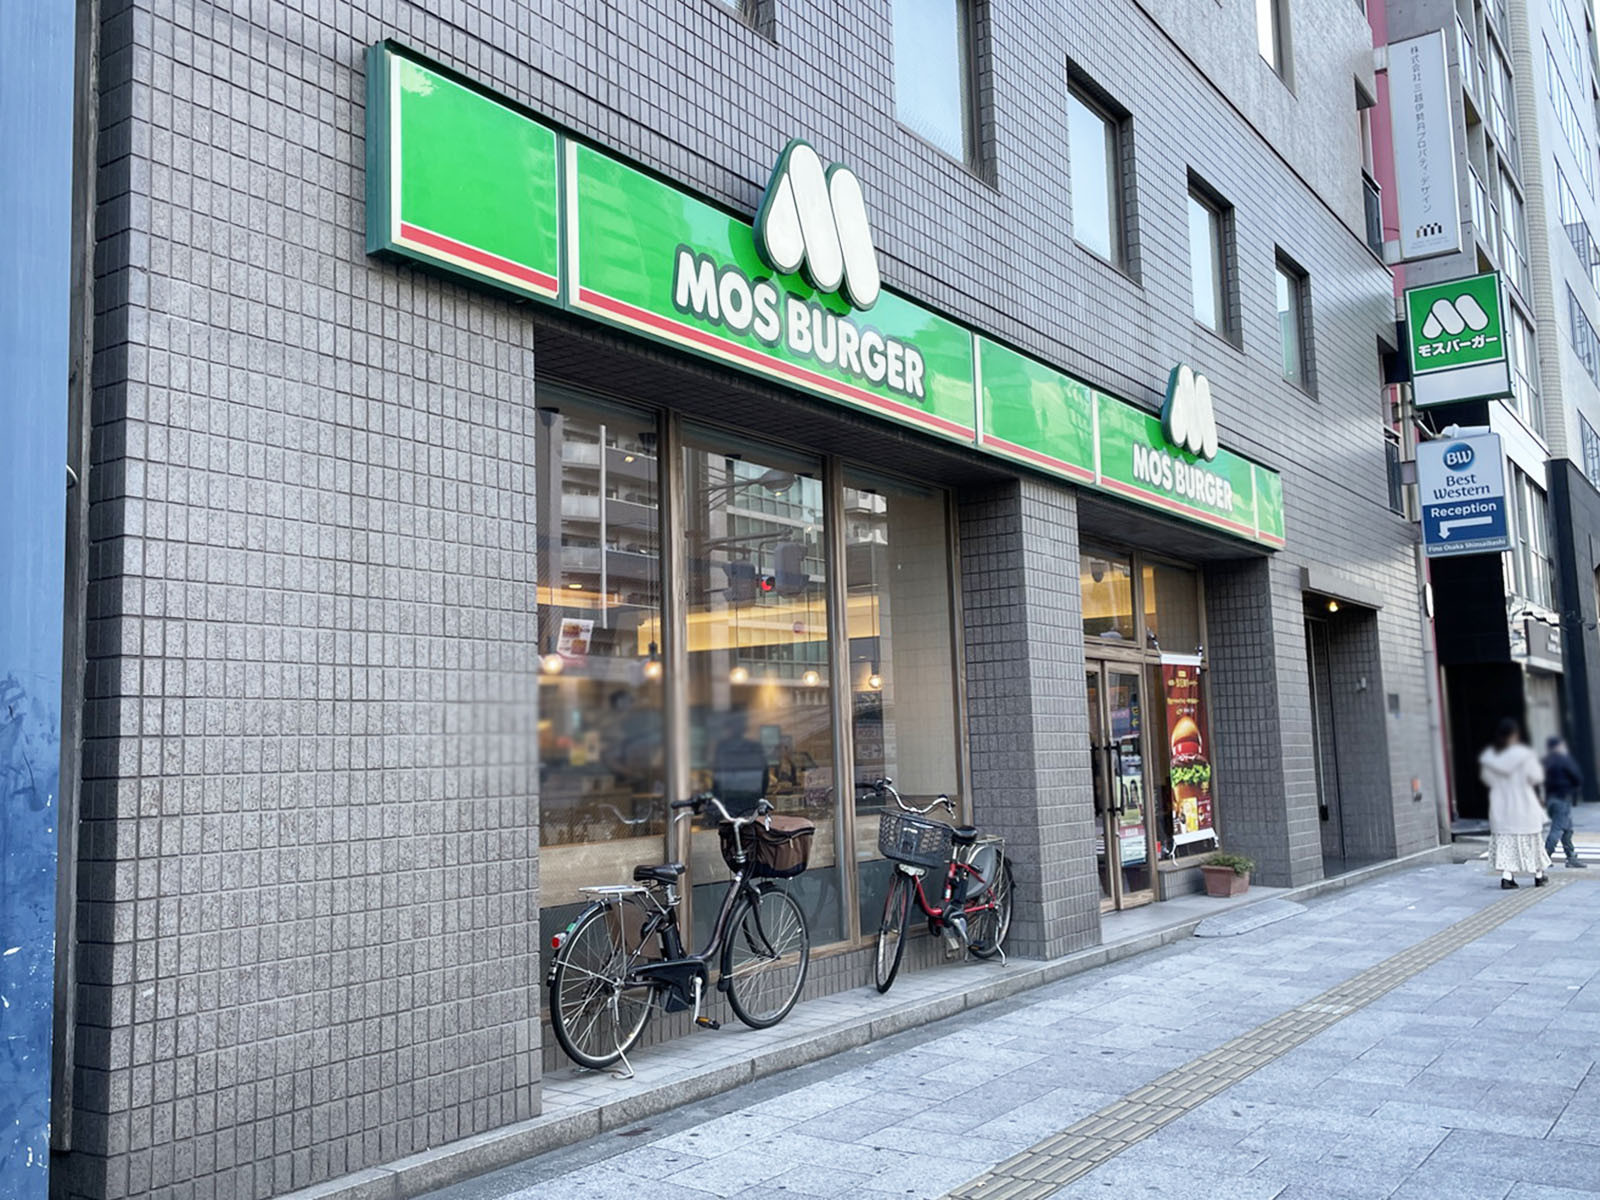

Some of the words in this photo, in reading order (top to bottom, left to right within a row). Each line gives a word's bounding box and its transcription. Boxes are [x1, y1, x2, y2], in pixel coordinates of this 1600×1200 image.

[674, 249, 780, 343] MOS
[786, 297, 925, 397] BURGER
[1418, 334, 1498, 357] モスバーガー
[1446, 450, 1472, 466] BW
[1133, 443, 1173, 491] MOS
[1174, 461, 1233, 511] BURGER
[1446, 473, 1477, 487] Best
[1433, 484, 1491, 500] Western
[1431, 502, 1497, 518] Reception
